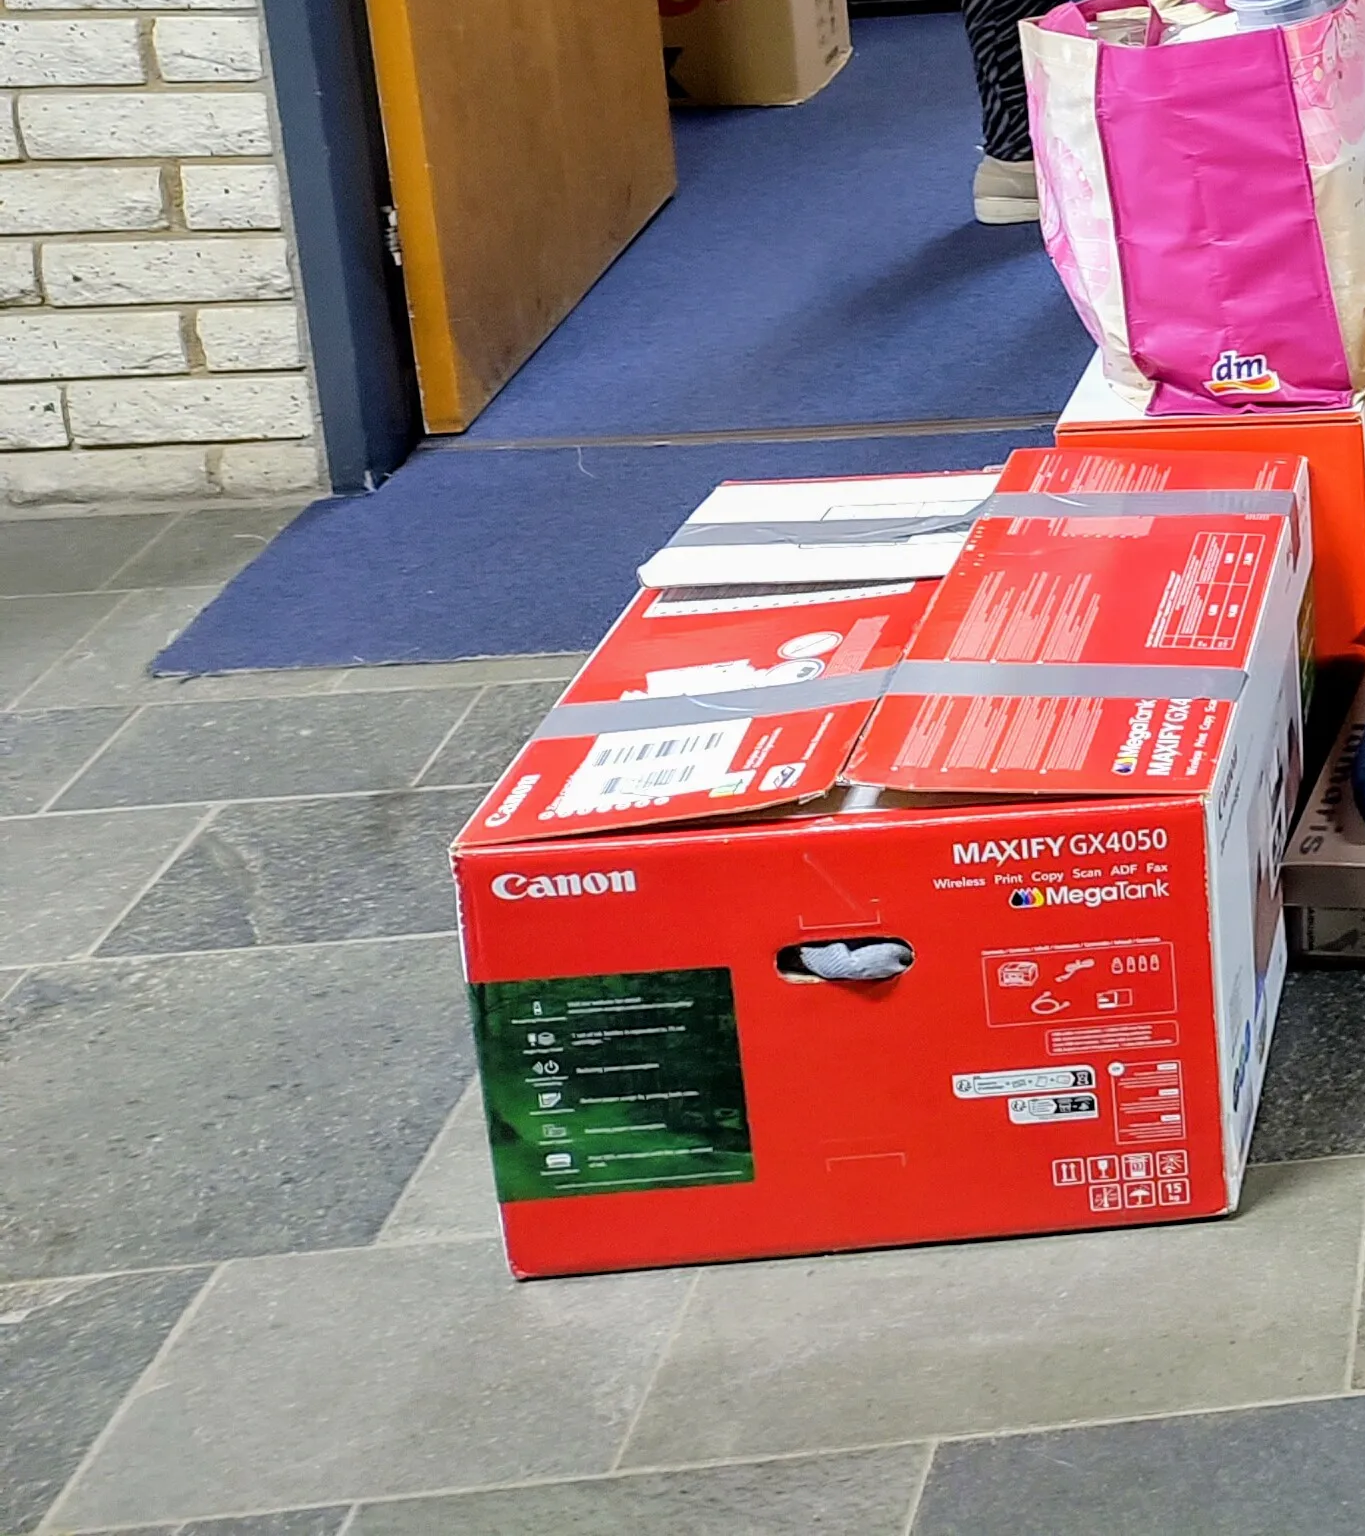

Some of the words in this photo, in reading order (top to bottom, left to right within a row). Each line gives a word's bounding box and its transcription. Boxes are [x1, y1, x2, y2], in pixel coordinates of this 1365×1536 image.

[1214, 353, 1264, 382] dm
[1117, 699, 1158, 758] MegaTank
[1146, 722, 1185, 776] MAXIFY
[485, 774, 541, 828] Canon
[952, 835, 1066, 866] MAXIFY
[1069, 828, 1168, 856] GX4050
[491, 869, 637, 901] Canon
[933, 875, 986, 890] Wireless
[994, 872, 1023, 886] Print
[1031, 870, 1064, 884] Copy
[1072, 866, 1102, 879] Scan
[1110, 863, 1138, 877] ADF
[1146, 862, 1168, 874] Fax
[1045, 880, 1170, 908] MegaTank
[1165, 1182, 1182, 1194] 15
